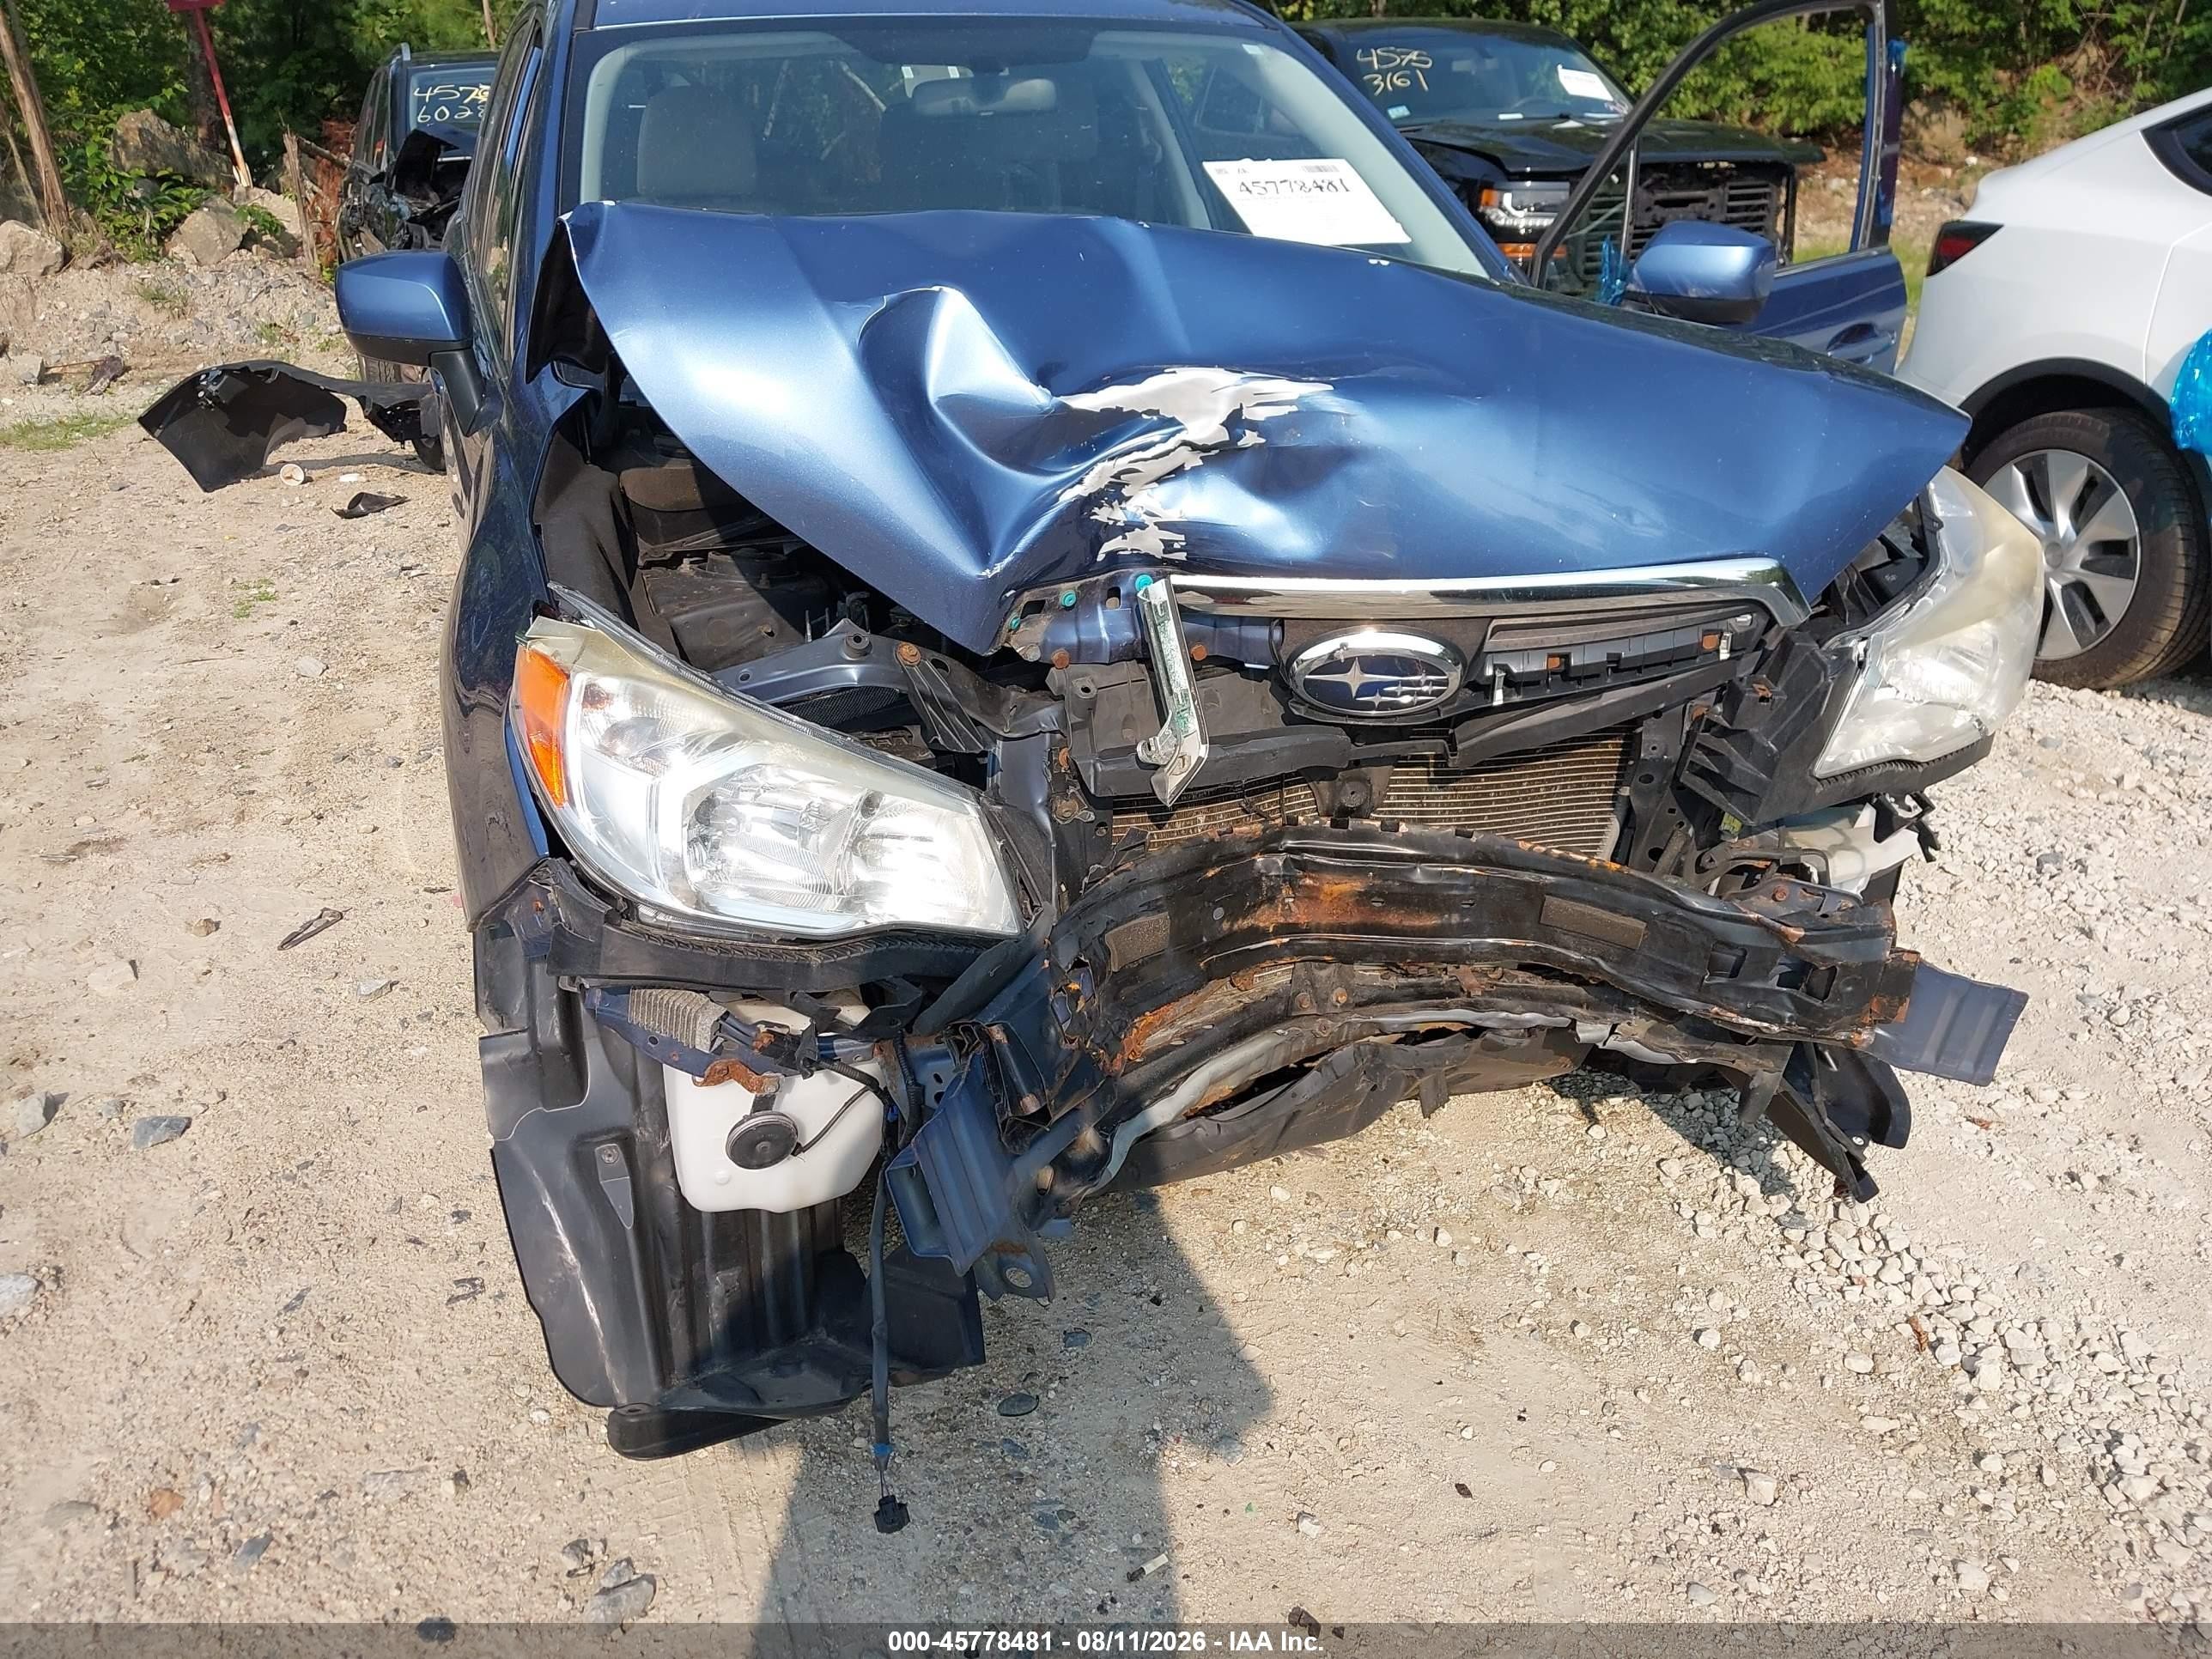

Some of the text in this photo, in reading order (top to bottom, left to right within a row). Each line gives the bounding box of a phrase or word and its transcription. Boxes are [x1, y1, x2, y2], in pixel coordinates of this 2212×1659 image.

[1356, 46, 1433, 70] 4575
[1362, 69, 1430, 97] 3161
[1239, 178, 1351, 196] 45778481
